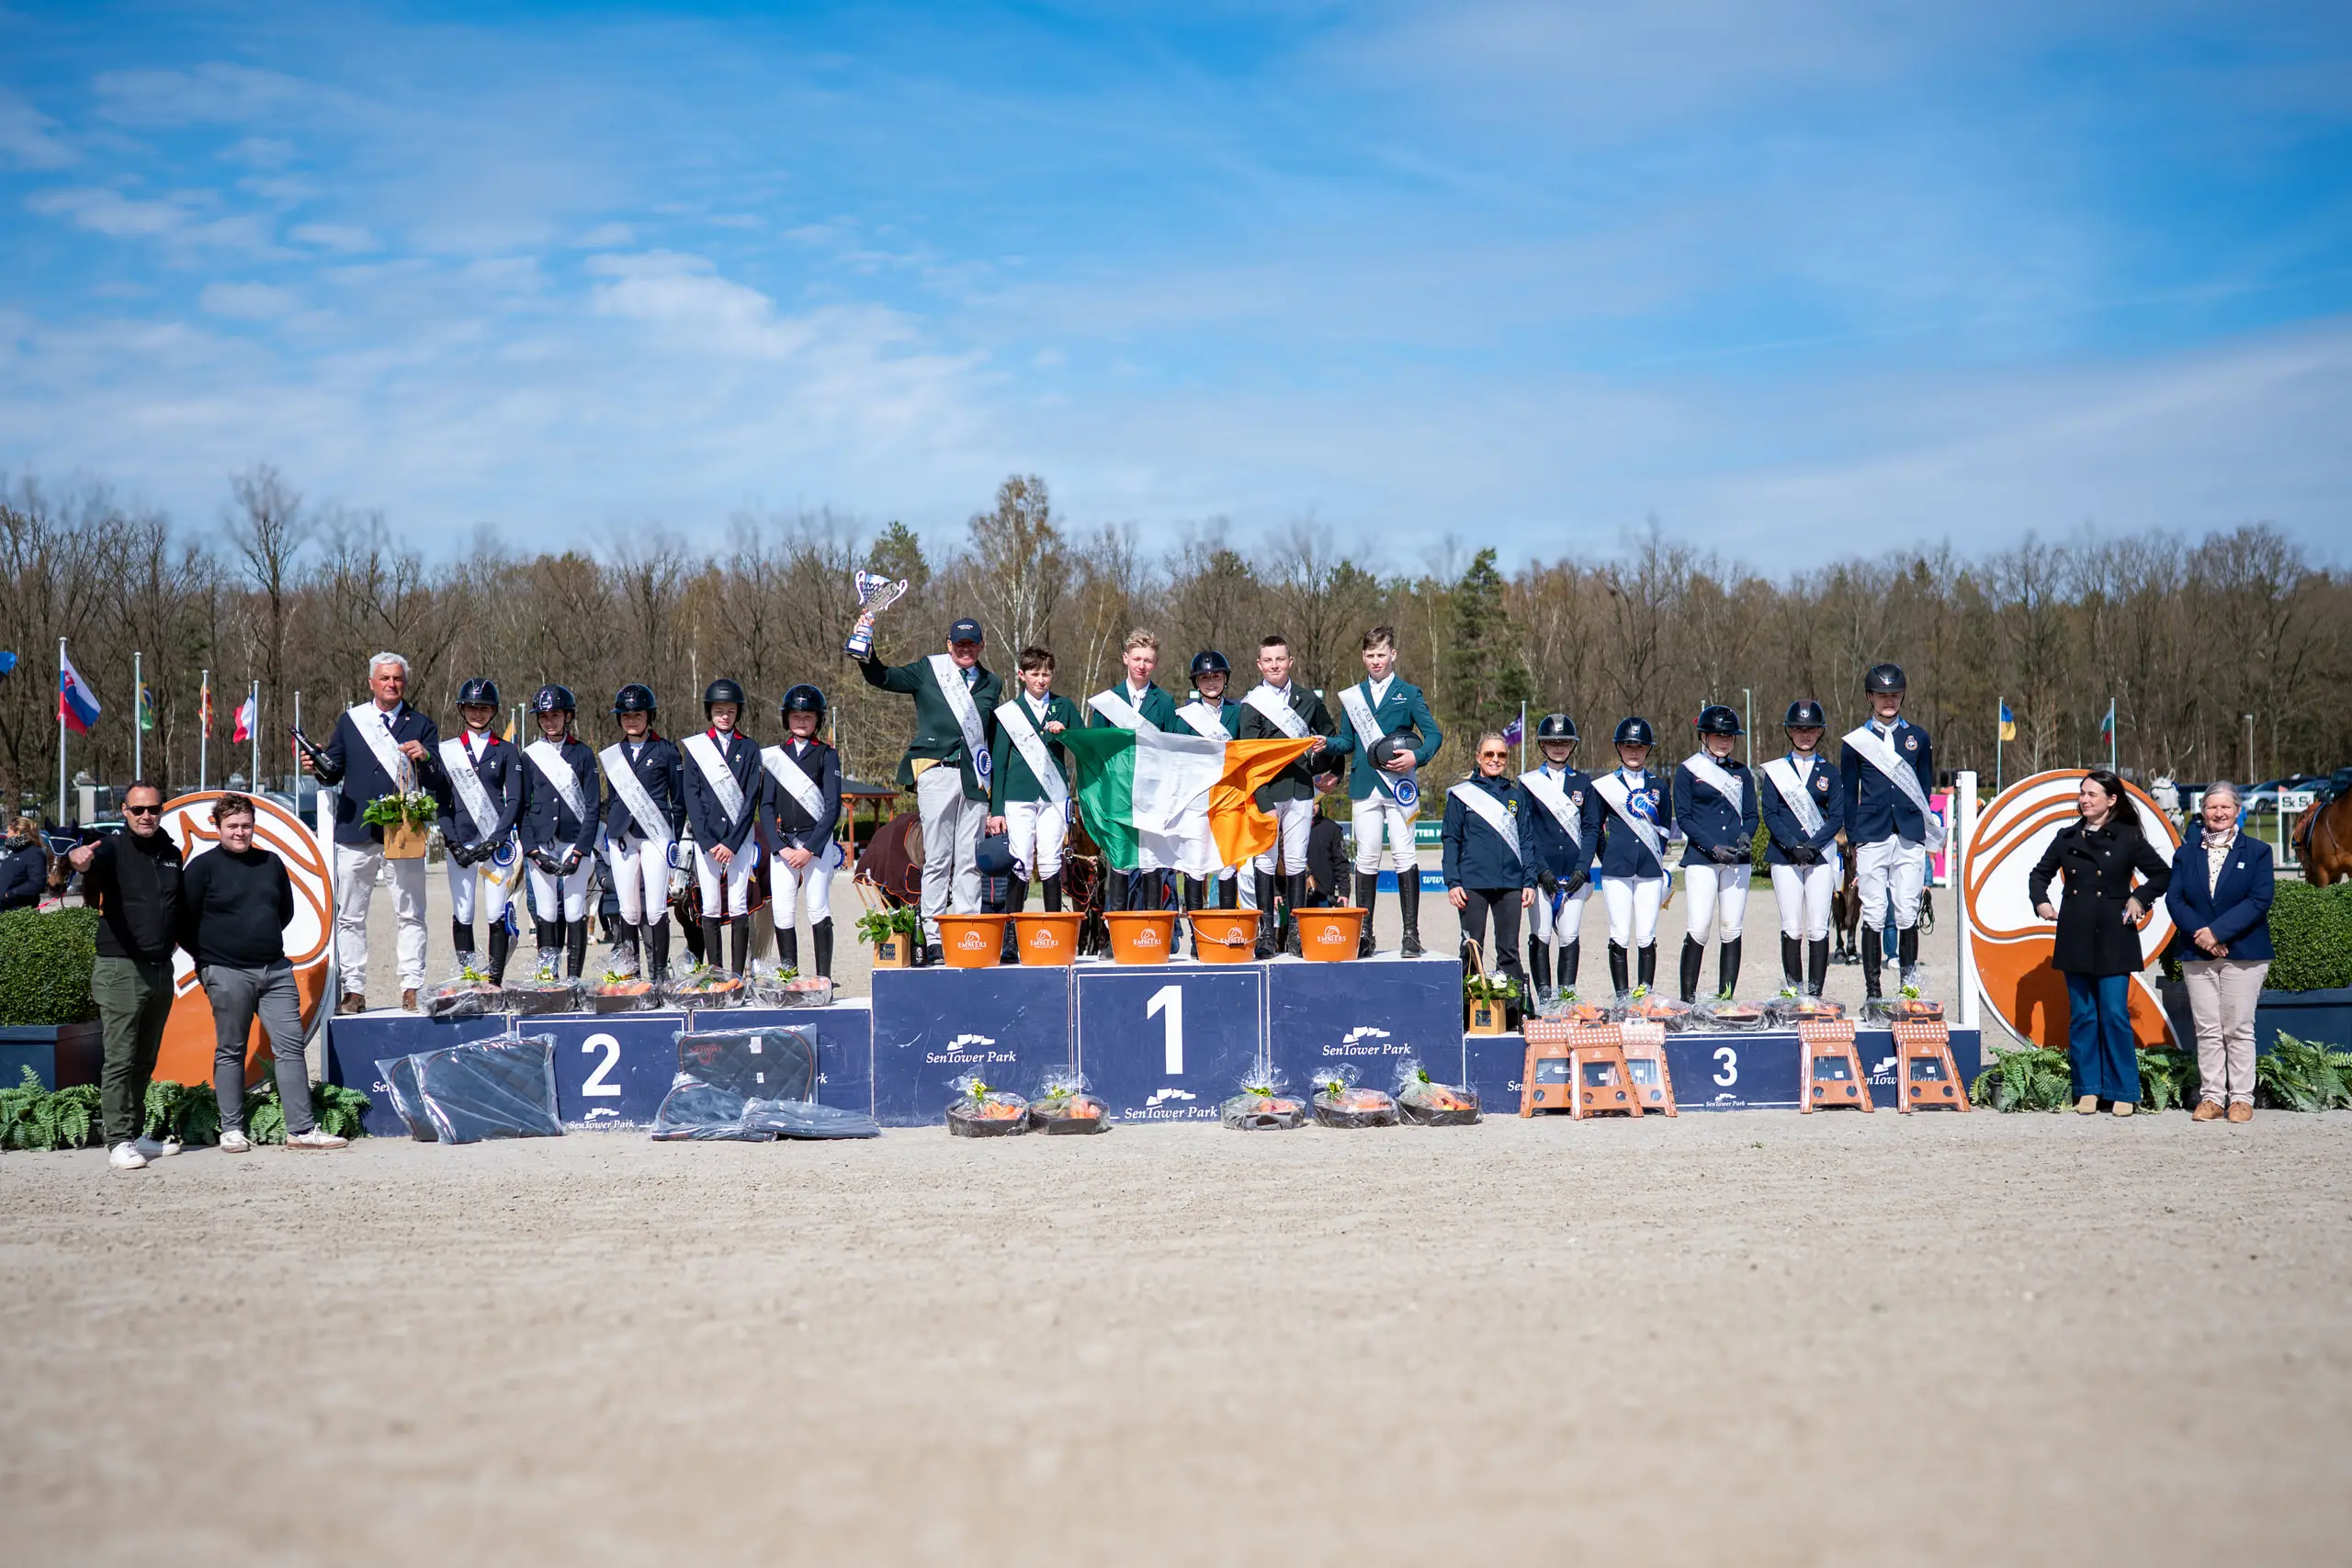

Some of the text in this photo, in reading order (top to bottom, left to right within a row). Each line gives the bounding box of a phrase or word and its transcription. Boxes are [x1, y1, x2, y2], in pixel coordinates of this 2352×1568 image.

[957, 941, 987, 949] EMMERS
[1147, 985, 1183, 1075] 1
[925, 1050, 1016, 1064] SenTower Park
[1323, 1043, 1411, 1056] SenTower Park
[582, 1032, 621, 1097] 2
[1713, 1046, 1738, 1087] 3
[1125, 1104, 1218, 1120] SenTower Park
[569, 1119, 635, 1130] SenTower Park
